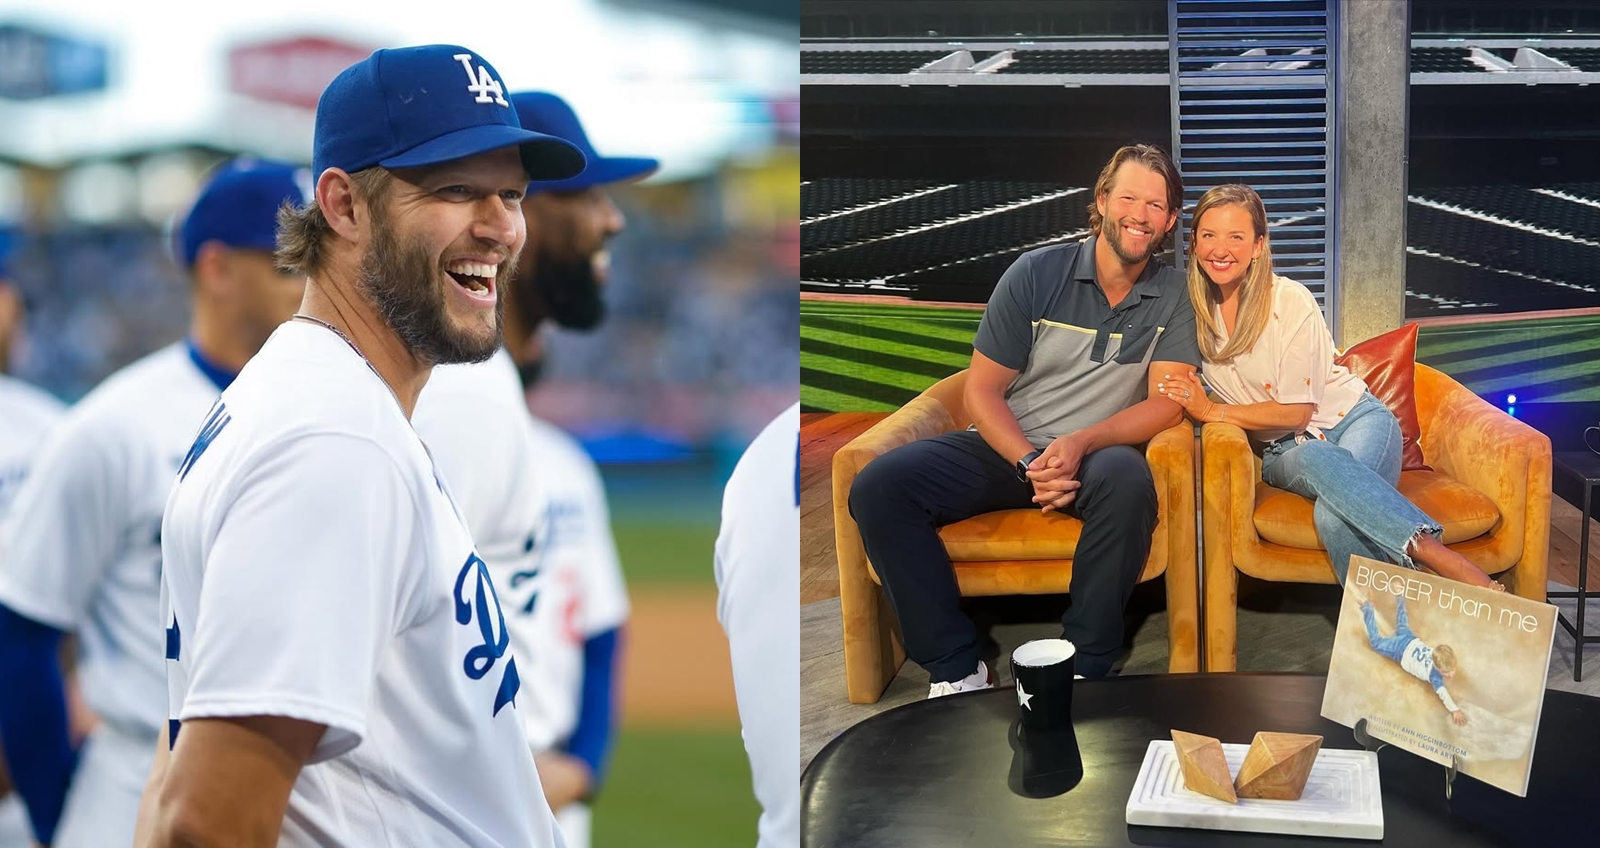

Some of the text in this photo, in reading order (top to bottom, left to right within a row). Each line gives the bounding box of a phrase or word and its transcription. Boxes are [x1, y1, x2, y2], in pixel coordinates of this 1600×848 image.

[453, 53, 509, 108] LA
[1355, 565, 1538, 633] BIGGER than me
[1368, 715, 1391, 727] WRITTEN
[1401, 726, 1416, 737] ANN
[1416, 731, 1467, 757] HIGGINBOTTOM
[1373, 724, 1408, 742] ILLUSTRATED
[1409, 738, 1417, 746] BY
[1417, 741, 1439, 755] LAURA
